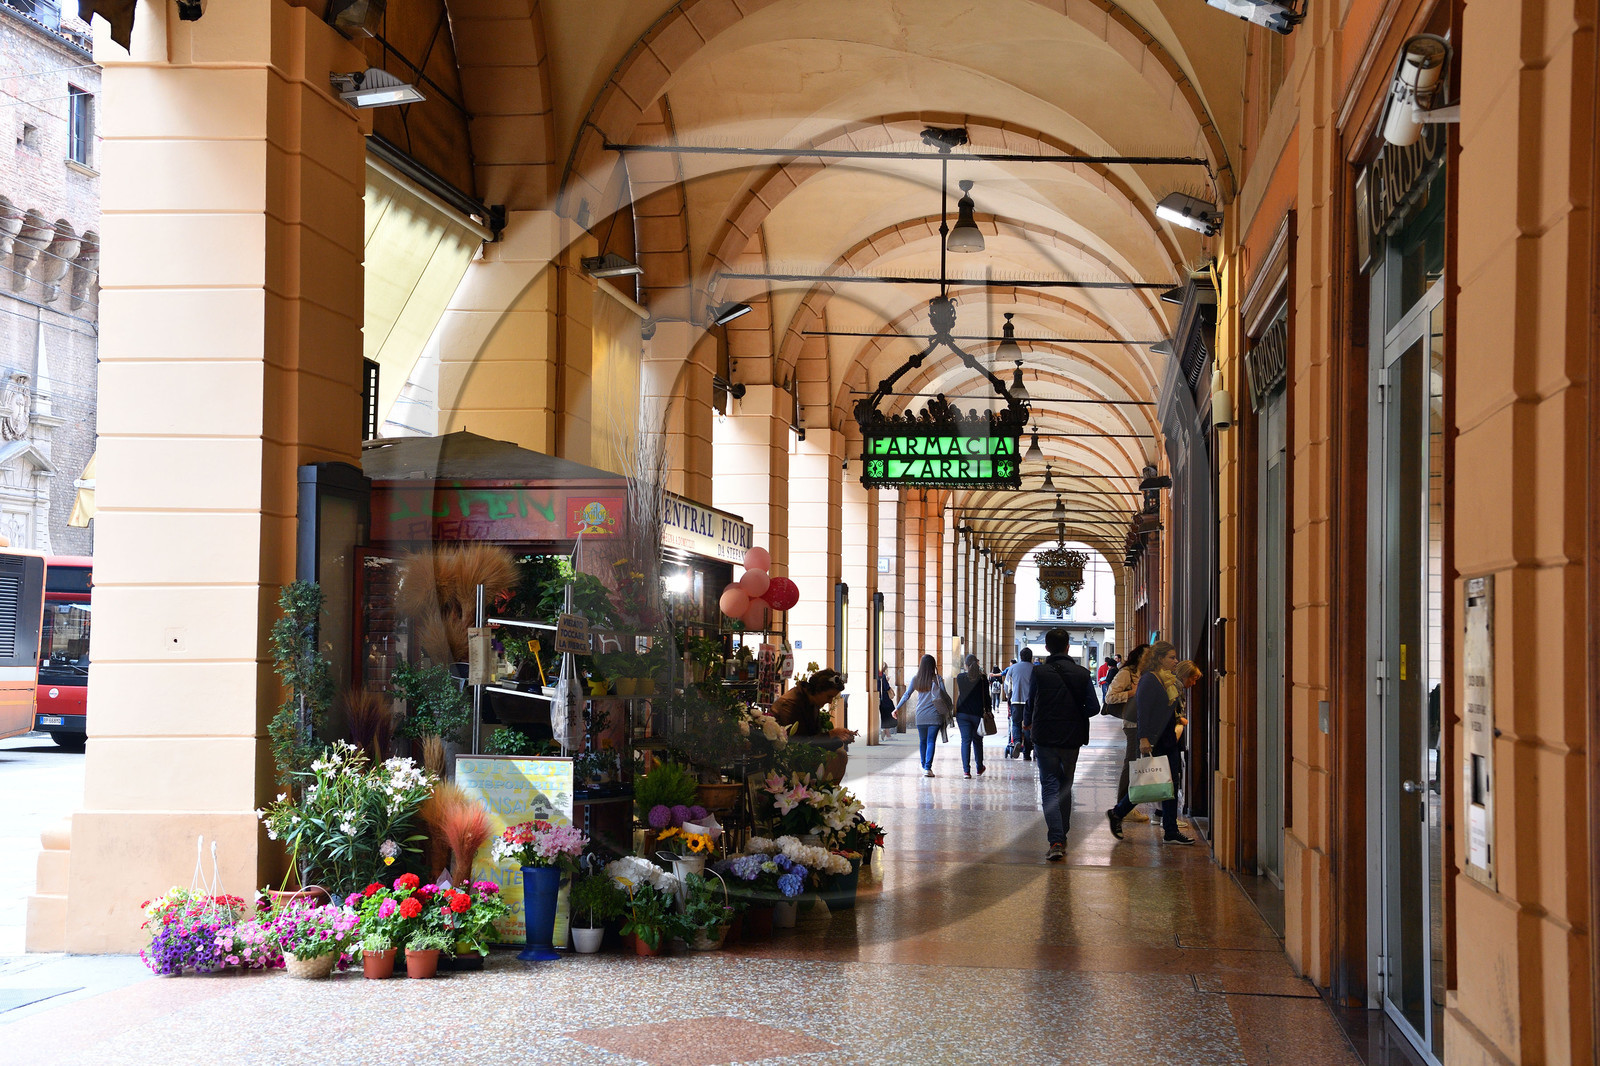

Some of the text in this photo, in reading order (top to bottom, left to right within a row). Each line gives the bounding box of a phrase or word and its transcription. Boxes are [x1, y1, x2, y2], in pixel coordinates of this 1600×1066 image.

[872, 436, 1011, 455] FARMACIA
[897, 459, 981, 478] ZARRI
[663, 498, 751, 549] ENTRAL FIORI
[717, 544, 747, 562] DA STEFAN
[460, 761, 570, 776] OFFERTE
[467, 779, 564, 791] DISPONIBILI
[478, 796, 526, 814] ONSAI
